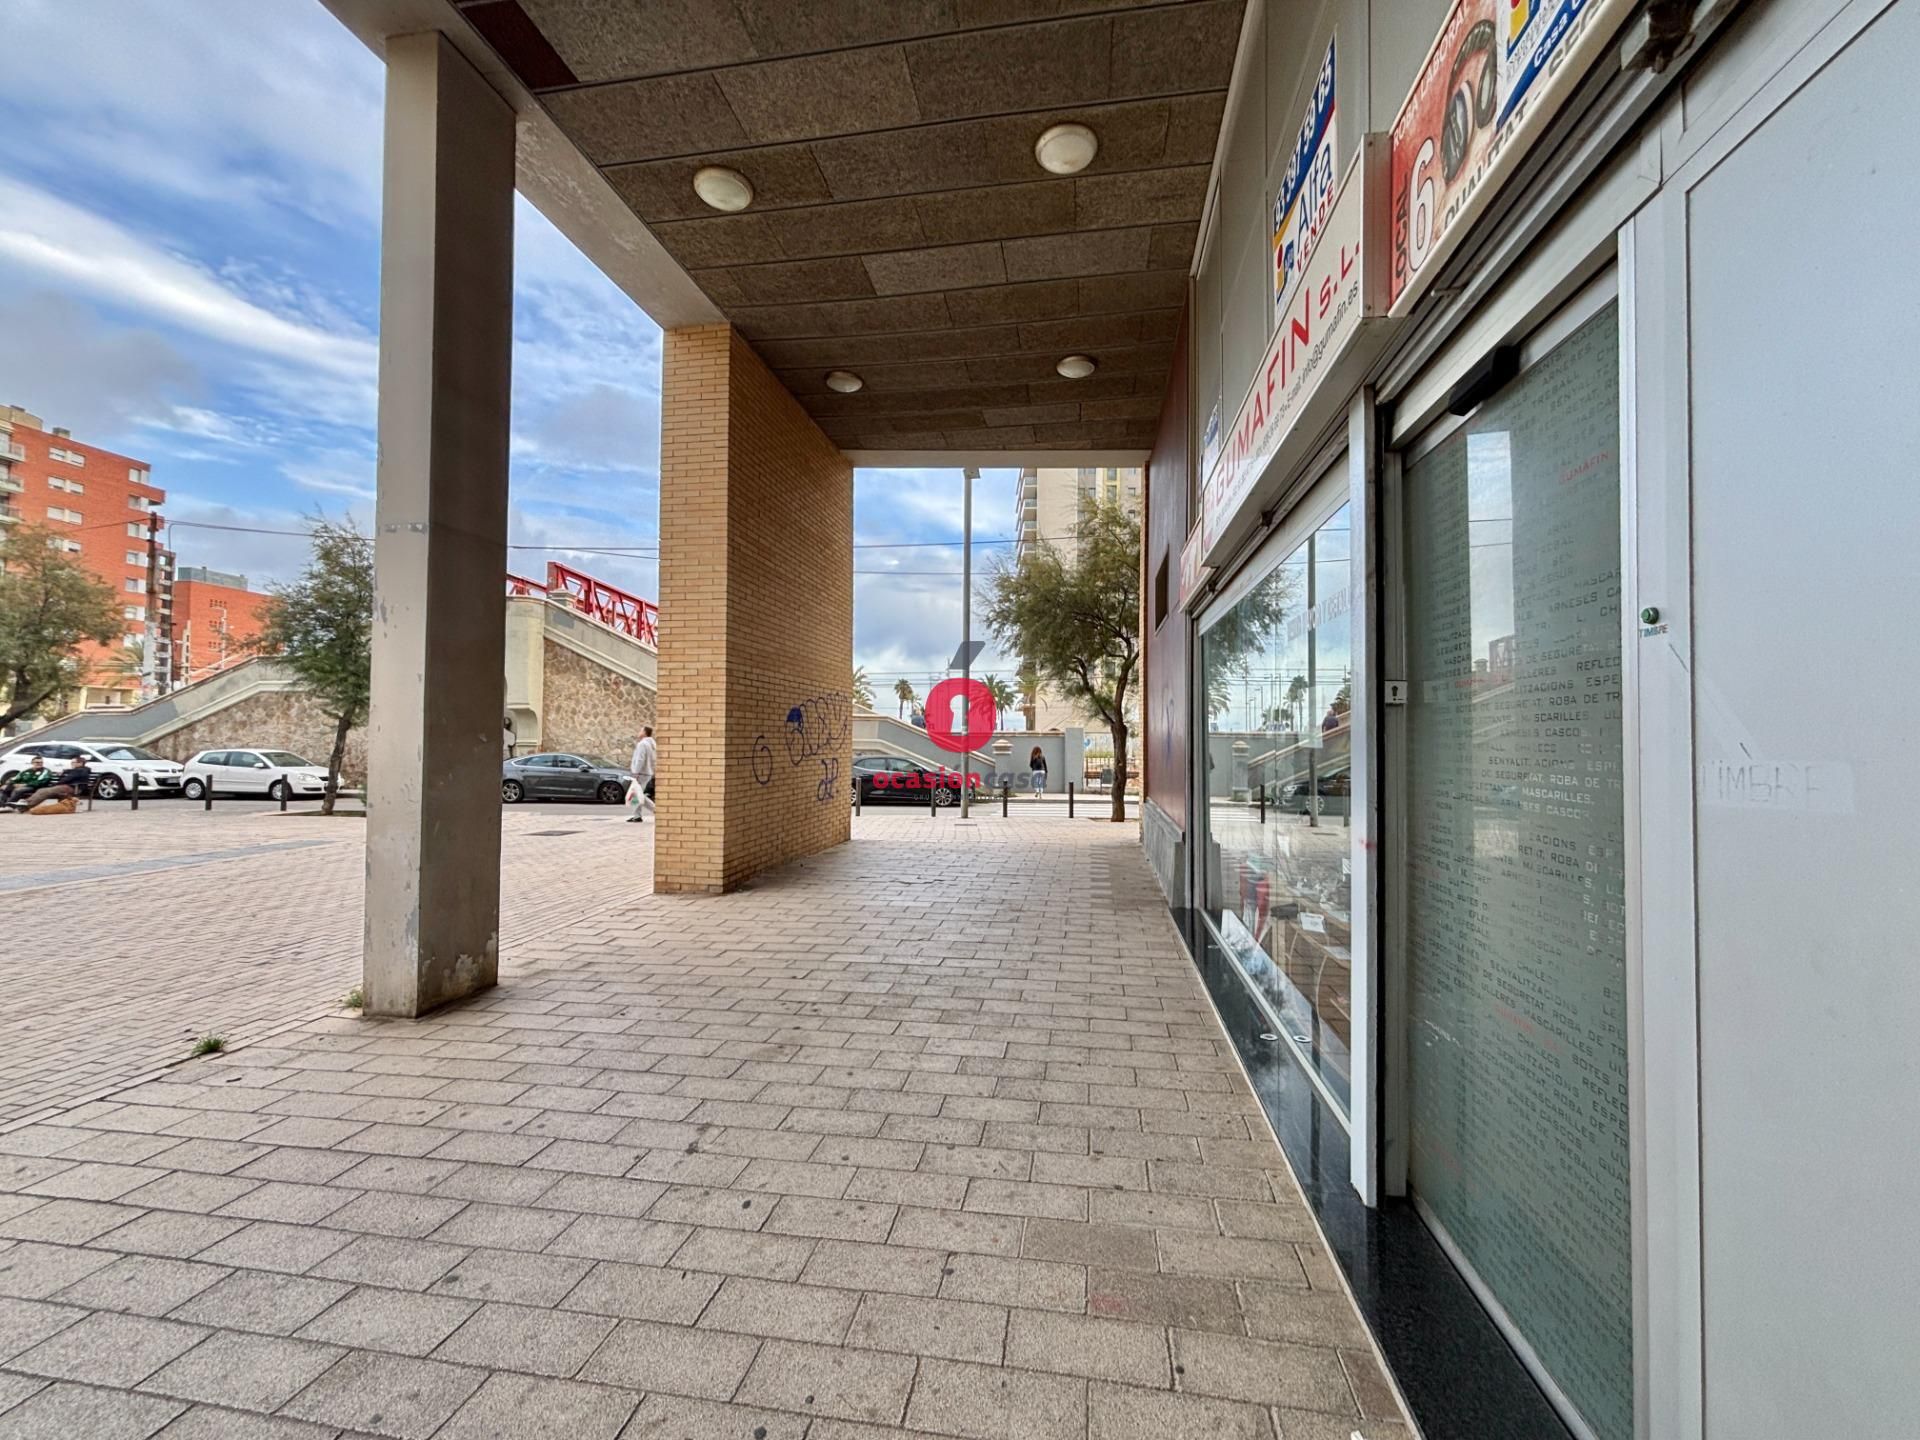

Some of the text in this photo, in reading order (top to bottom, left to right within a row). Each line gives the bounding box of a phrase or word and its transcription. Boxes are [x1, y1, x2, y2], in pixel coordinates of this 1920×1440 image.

[1534, 12, 1568, 68] Casa
[1297, 142, 1332, 253] Alfa
[1297, 178, 1334, 273] VENDE
[1409, 137, 1434, 271] 6
[1216, 287, 1310, 506] GUMAFIN
